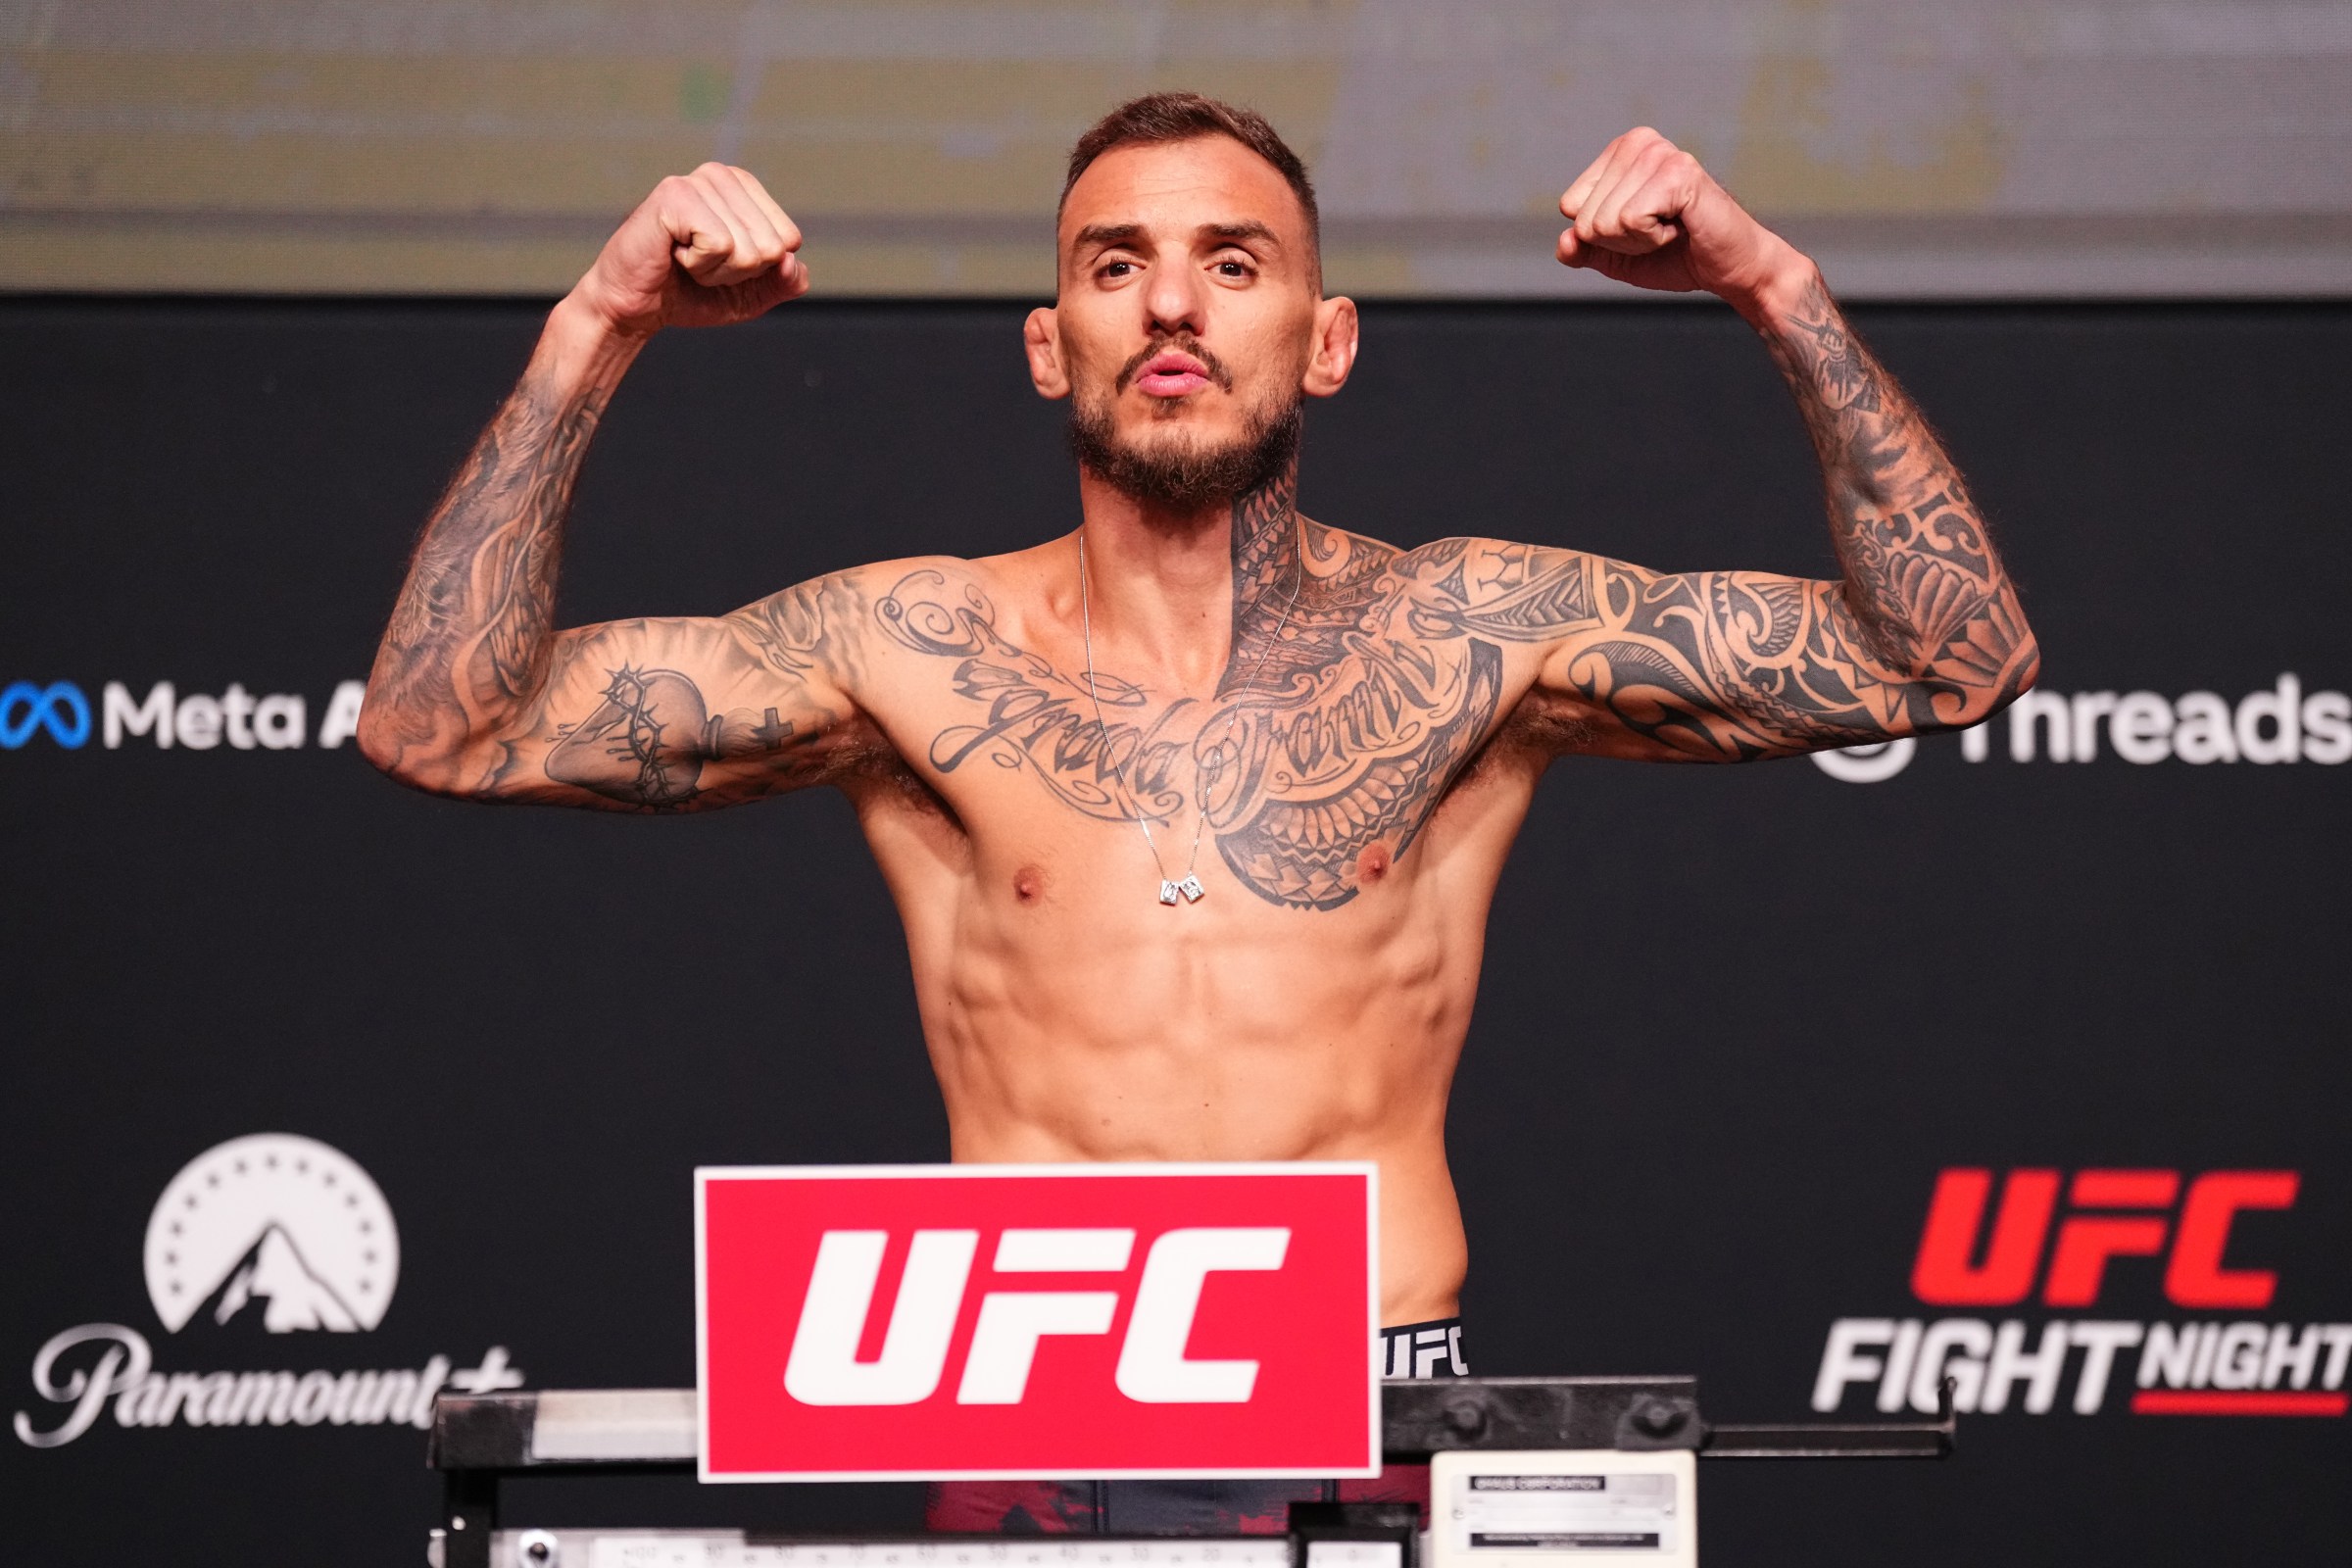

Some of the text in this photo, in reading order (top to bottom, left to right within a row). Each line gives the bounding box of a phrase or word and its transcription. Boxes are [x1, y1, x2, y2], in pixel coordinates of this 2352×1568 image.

[102, 679, 370, 751] Meta A
[1908, 1166, 2302, 1310] UFC
[784, 1227, 1293, 1407] UFC
[1378, 1326, 1469, 1380] UFC
[1810, 1317, 2352, 1417] FIGHT NIGHT
